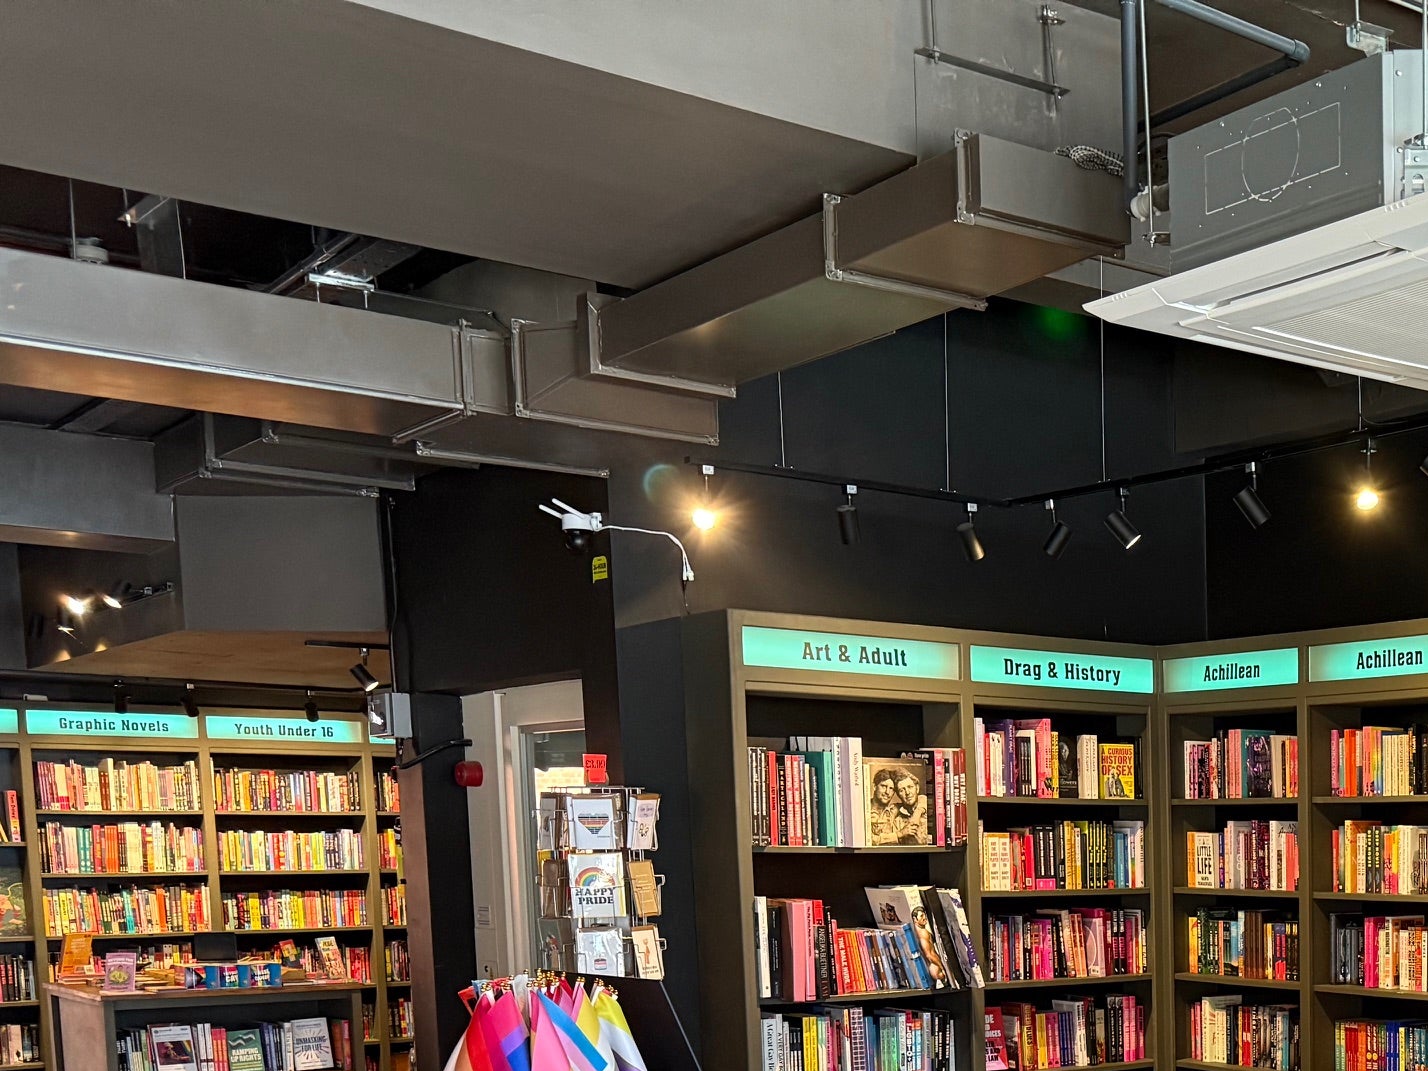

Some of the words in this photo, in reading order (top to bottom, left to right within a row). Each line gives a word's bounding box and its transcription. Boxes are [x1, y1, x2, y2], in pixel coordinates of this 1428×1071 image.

[801, 641, 833, 665] Art
[837, 643, 851, 663] &
[858, 644, 907, 668] Adult
[1356, 647, 1424, 672] Achillean
[1003, 657, 1041, 682] Drag
[1045, 661, 1059, 679] &
[1064, 662, 1122, 686] History
[1203, 661, 1261, 683] Achillean
[59, 717, 116, 732] Graphic
[122, 719, 169, 732] Novels
[235, 723, 273, 736] Youth
[279, 725, 317, 737] Under
[321, 726, 334, 737] 16
[1101, 756, 1133, 764] HISTORY
[1102, 766, 1112, 776] OF
[1117, 765, 1133, 776] SEX
[1197, 846, 1212, 857] LITTLE
[1197, 856, 1212, 874] LIFE
[575, 887, 615, 896] HAPPY
[579, 896, 614, 905] PRIDE
[837, 936, 845, 951] THE
[839, 951, 847, 968] MALE
[842, 968, 850, 984] NUDE
[295, 1036, 327, 1045] UNMASKING
[767, 1027, 775, 1044] Great
[240, 1054, 261, 1062] RIGHTS
[767, 1046, 775, 1060] Gay
